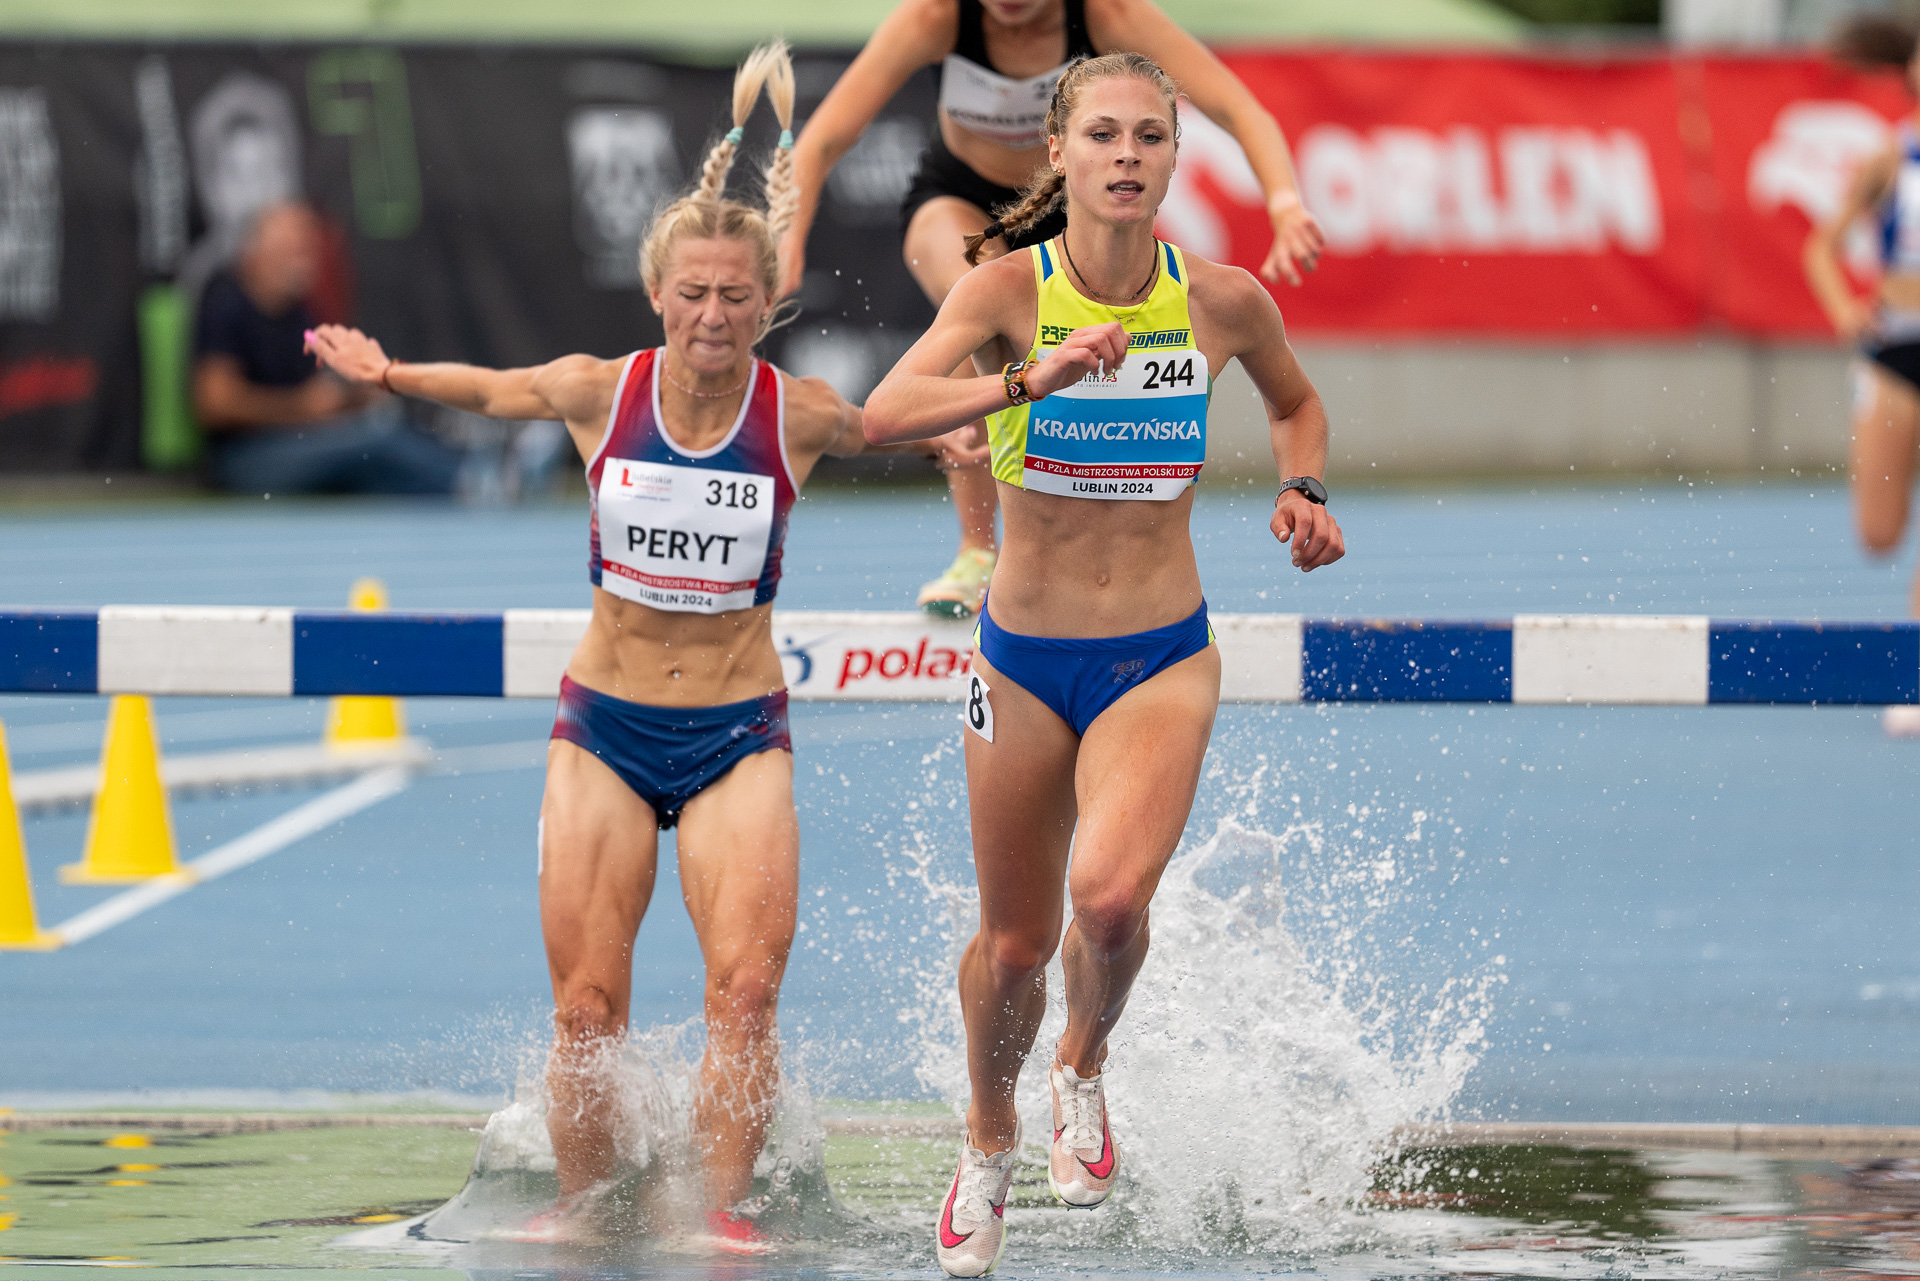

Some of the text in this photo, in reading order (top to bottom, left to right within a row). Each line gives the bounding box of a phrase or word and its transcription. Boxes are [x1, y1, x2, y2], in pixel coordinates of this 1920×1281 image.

[1143, 358, 1194, 389] 244
[1034, 418, 1201, 440] KRAWCZYŃSKA
[1034, 461, 1195, 476] 41. PZLA MISTRZOSTWA POLSKI U23
[706, 479, 757, 509] 318
[1072, 482, 1153, 494] LUBLIN 2024
[627, 525, 738, 565] PERYT
[620, 567, 638, 579] PZLA
[639, 574, 701, 589] MISTRZOSTWA
[640, 588, 712, 606] LUBLIN 2024
[968, 677, 985, 730] 8
